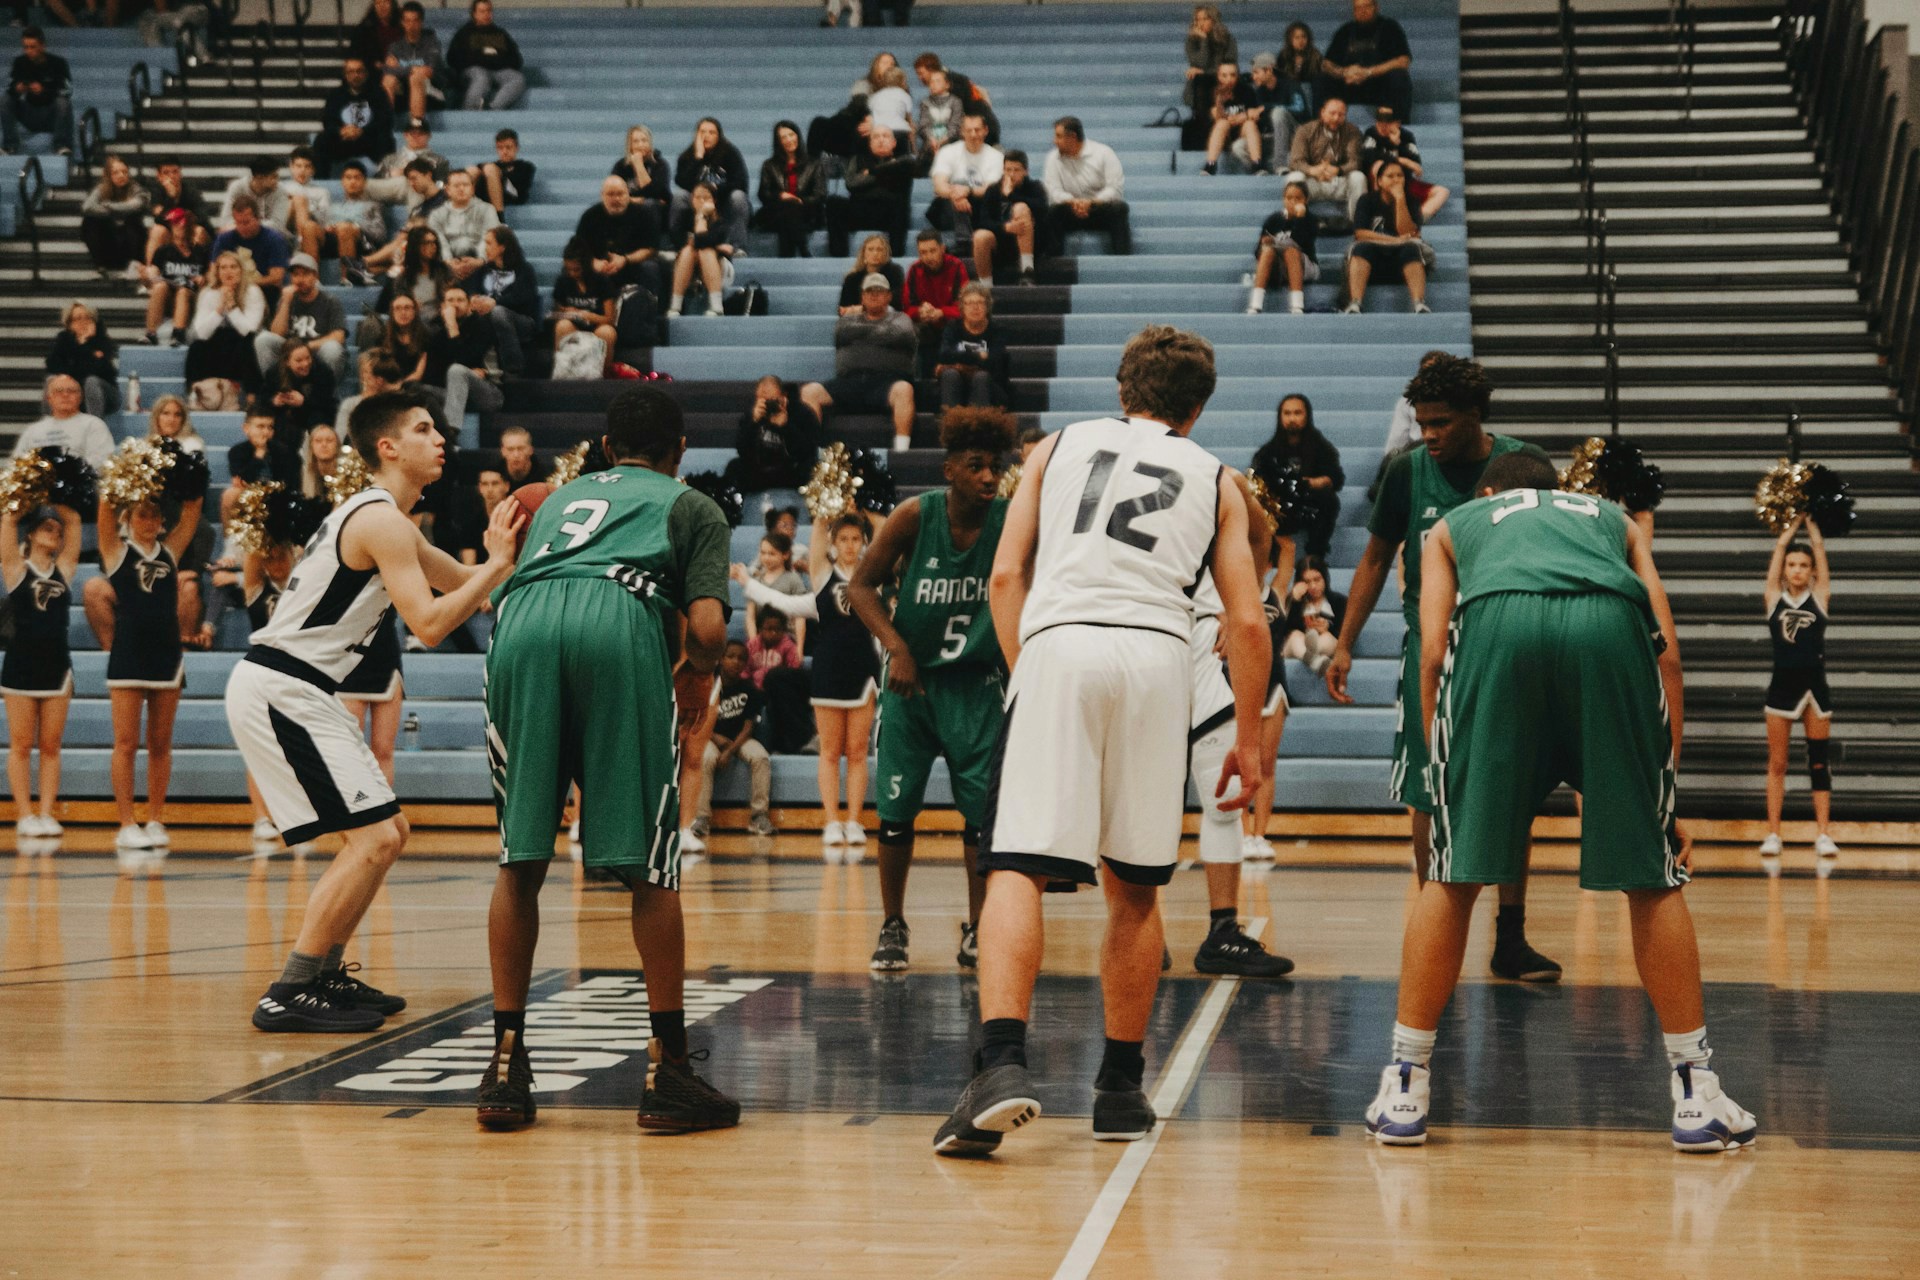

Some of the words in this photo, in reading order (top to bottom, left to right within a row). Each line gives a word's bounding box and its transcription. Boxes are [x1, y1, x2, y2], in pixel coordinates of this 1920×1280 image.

[1073, 449, 1184, 553] 12
[532, 498, 611, 560] 3
[915, 576, 989, 604] RANCH
[940, 614, 973, 660] 5
[887, 774, 903, 800] 5
